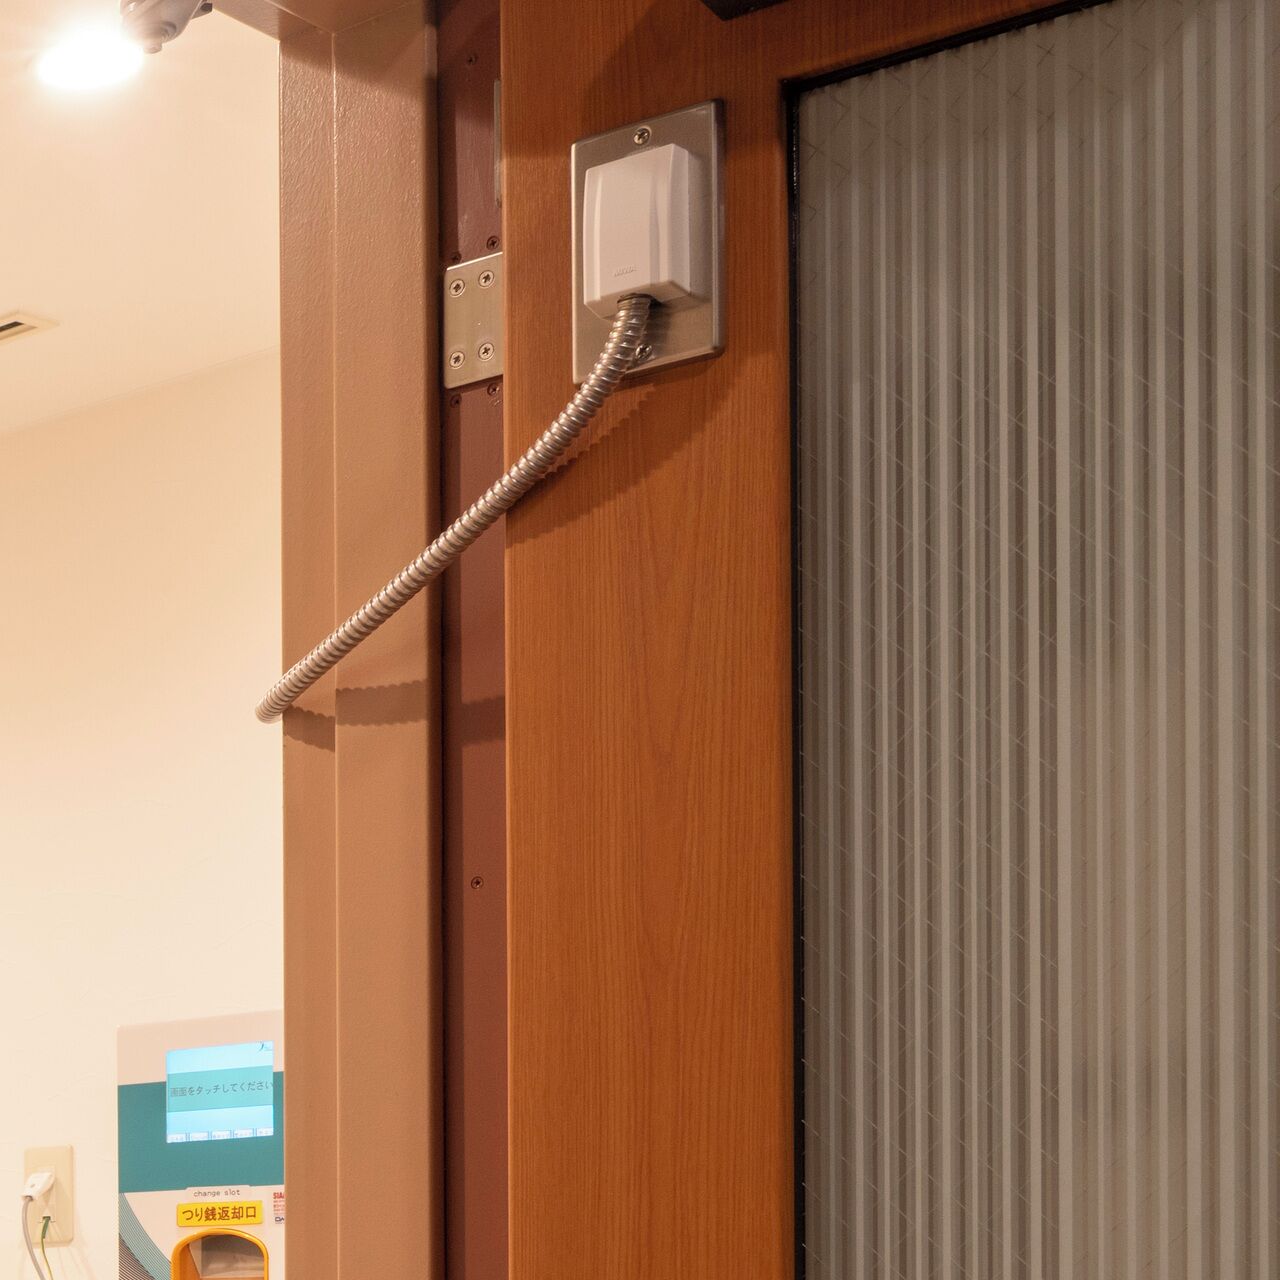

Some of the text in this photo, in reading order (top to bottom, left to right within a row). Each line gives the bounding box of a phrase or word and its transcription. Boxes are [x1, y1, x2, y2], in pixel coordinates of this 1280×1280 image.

[193, 1188, 241, 1198] change slot
[182, 1206, 257, 1222] つり銭返却口
